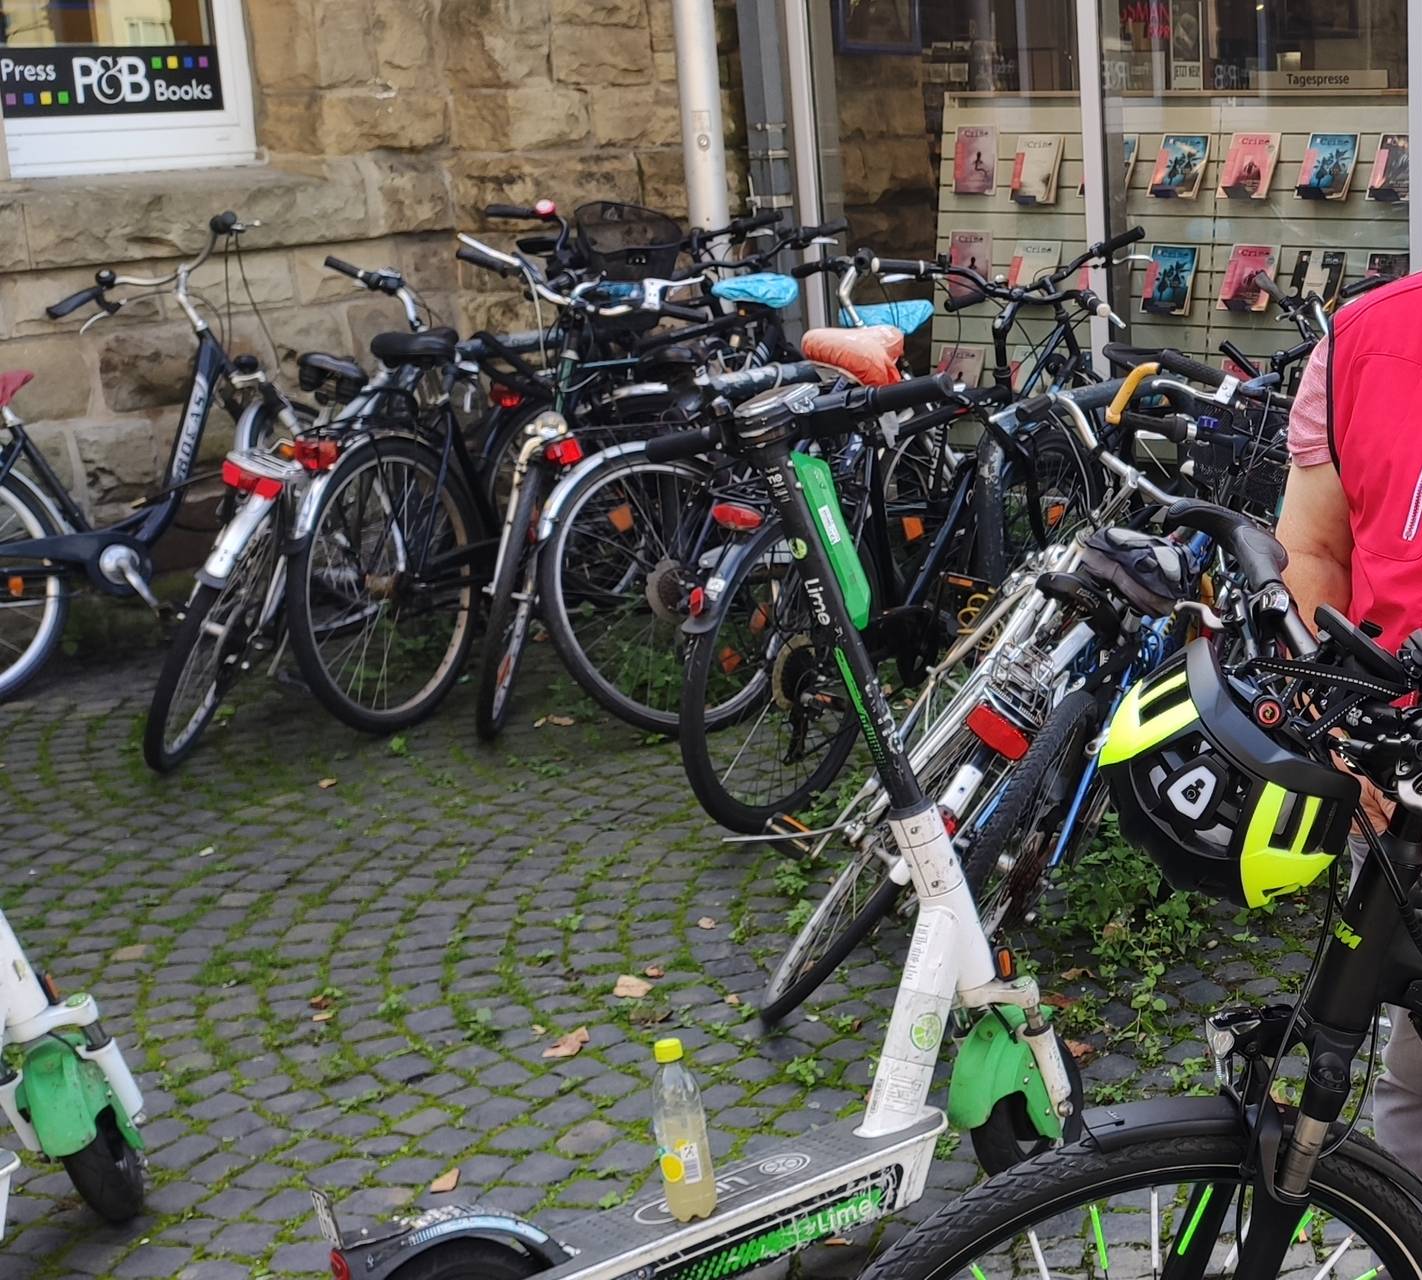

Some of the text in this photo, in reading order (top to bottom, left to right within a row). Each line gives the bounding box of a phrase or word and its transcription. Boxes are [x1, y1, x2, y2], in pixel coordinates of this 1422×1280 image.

[1, 58, 57, 82] Press
[72, 56, 150, 104] P&B
[1287, 73, 1350, 87] Tagespresse
[154, 79, 213, 102] Books
[964, 129, 989, 138] Crime
[1026, 140, 1053, 148] Crime
[1241, 137, 1270, 146] Crime
[958, 235, 984, 244] Crime
[1026, 246, 1052, 254] Crime
[1241, 249, 1271, 257] Crime
[804, 577, 831, 626] Lime
[1335, 918, 1363, 950] KTM
[817, 1199, 874, 1233] Lime
